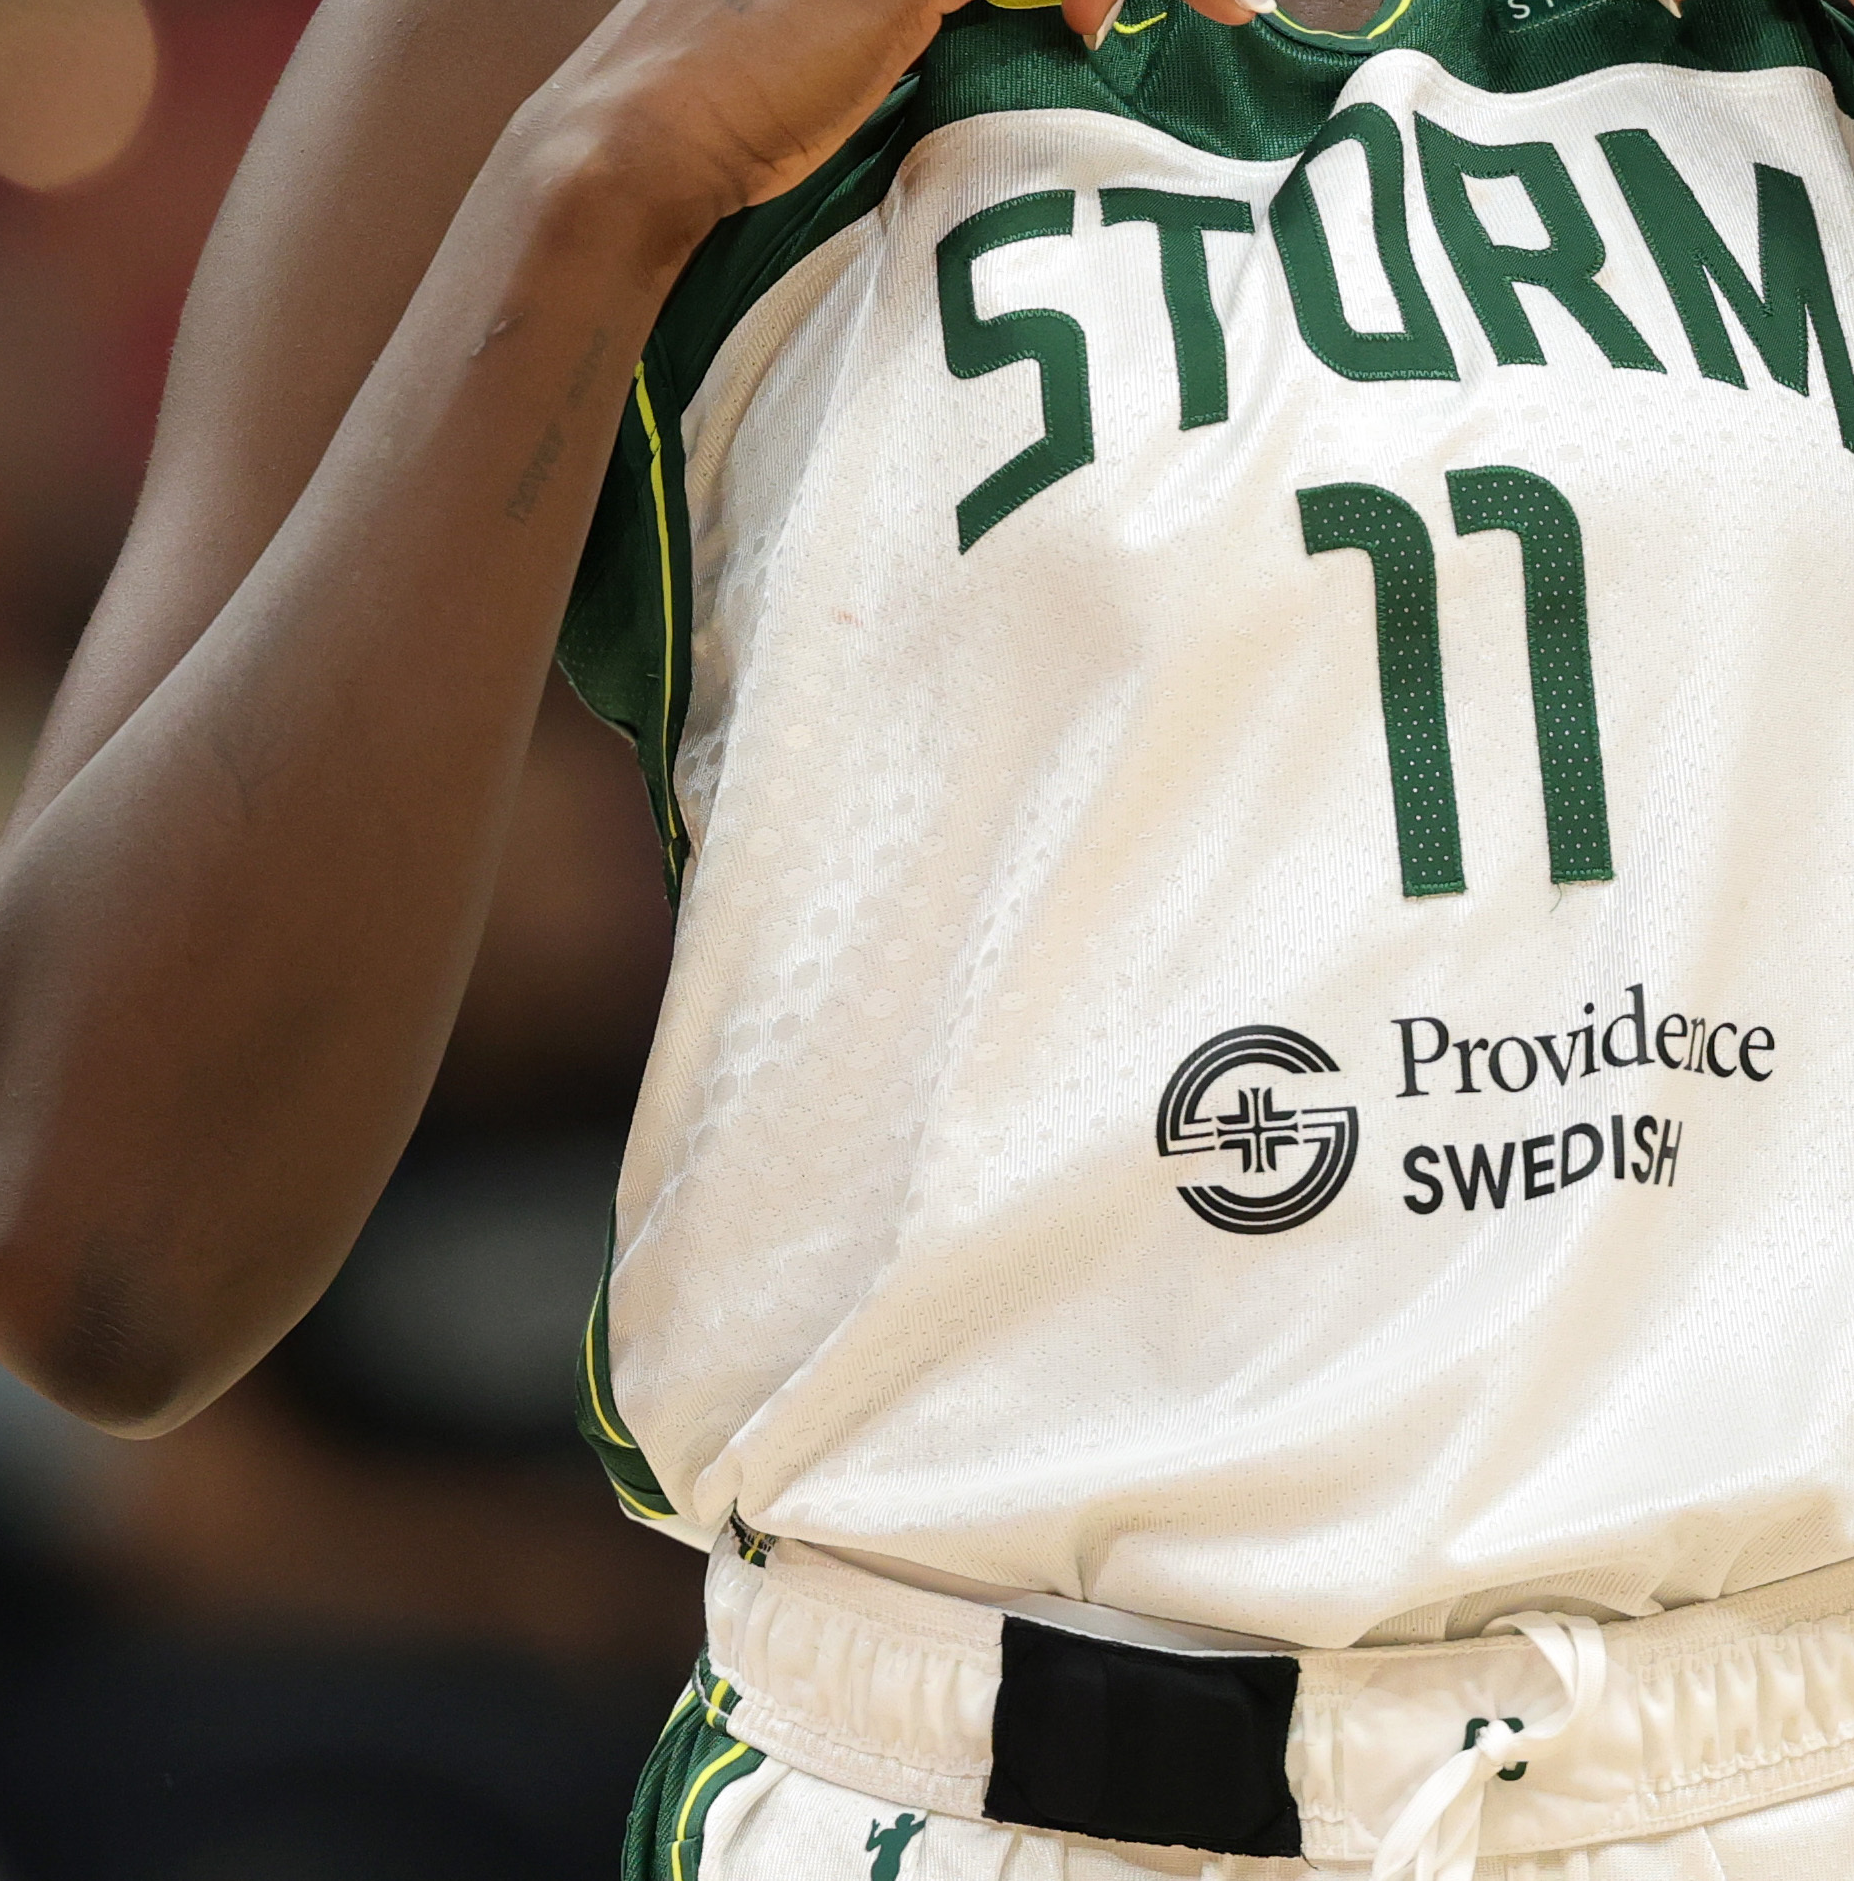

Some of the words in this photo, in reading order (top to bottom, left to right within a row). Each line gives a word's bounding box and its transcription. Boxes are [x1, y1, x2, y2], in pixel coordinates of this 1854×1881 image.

[1295, 465, 1614, 899] 11
[1391, 983, 1776, 1099] Providence
[1403, 1114, 1684, 1215] SWEDISH
